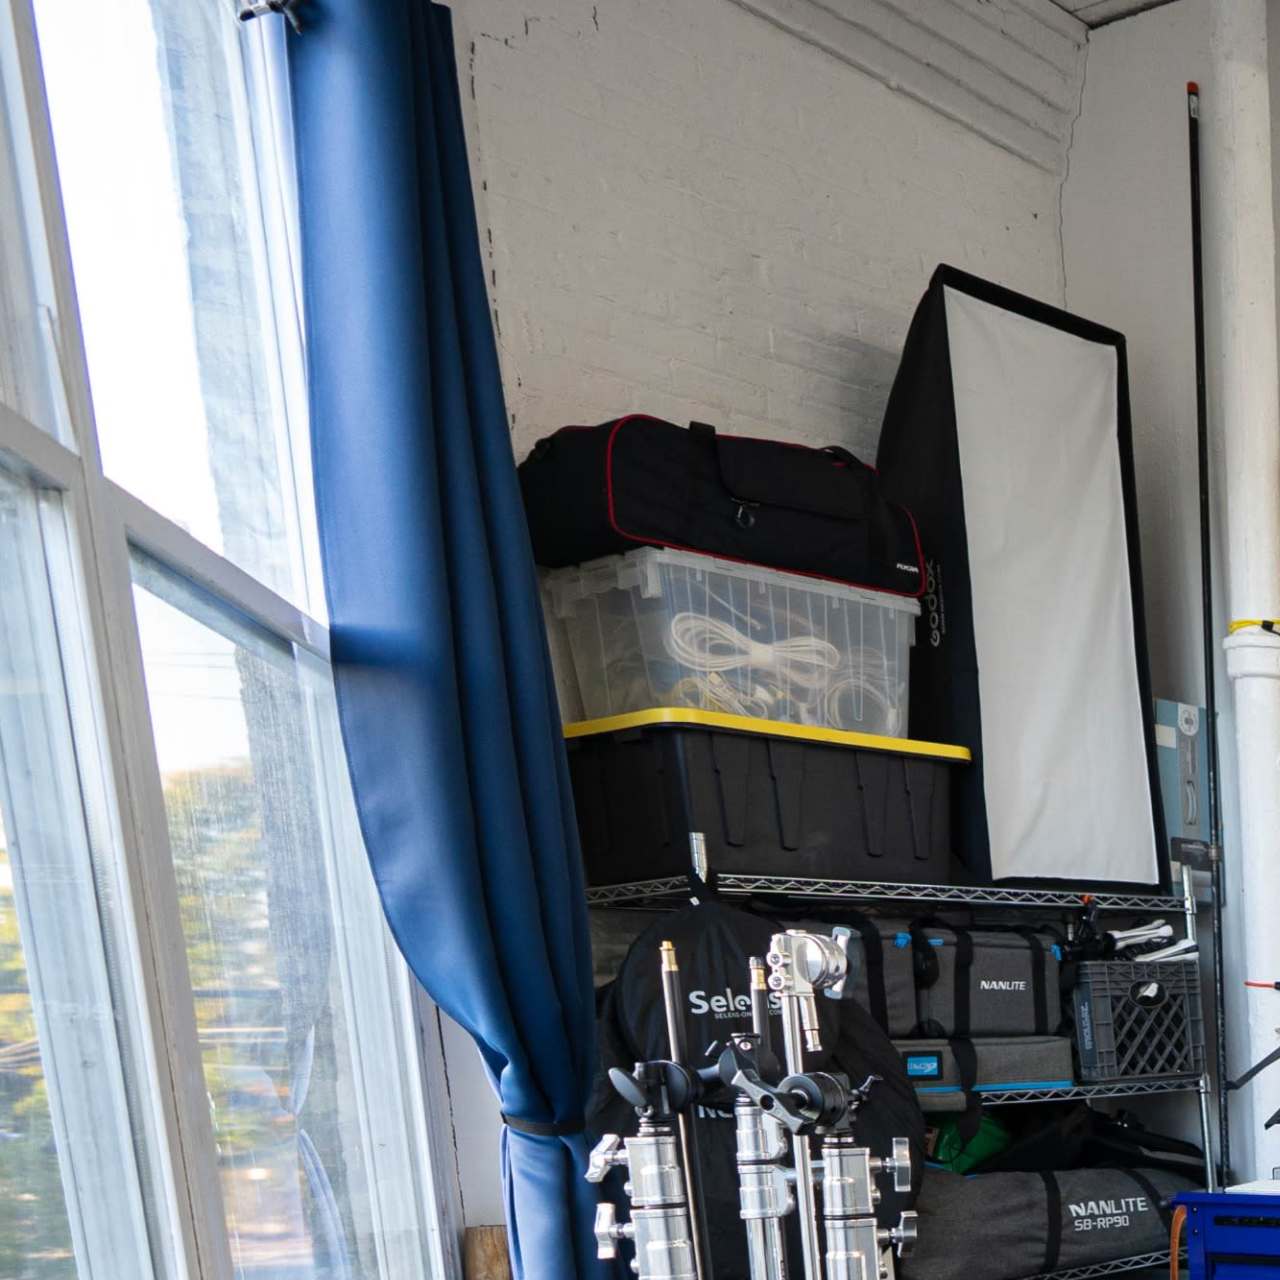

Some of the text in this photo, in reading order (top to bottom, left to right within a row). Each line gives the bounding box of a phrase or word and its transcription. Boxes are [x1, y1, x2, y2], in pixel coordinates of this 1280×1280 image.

[689, 988, 782, 1014] Seles
[1068, 1197, 1149, 1217] NANLITE
[1074, 1215, 1130, 1231] SB-RP90
